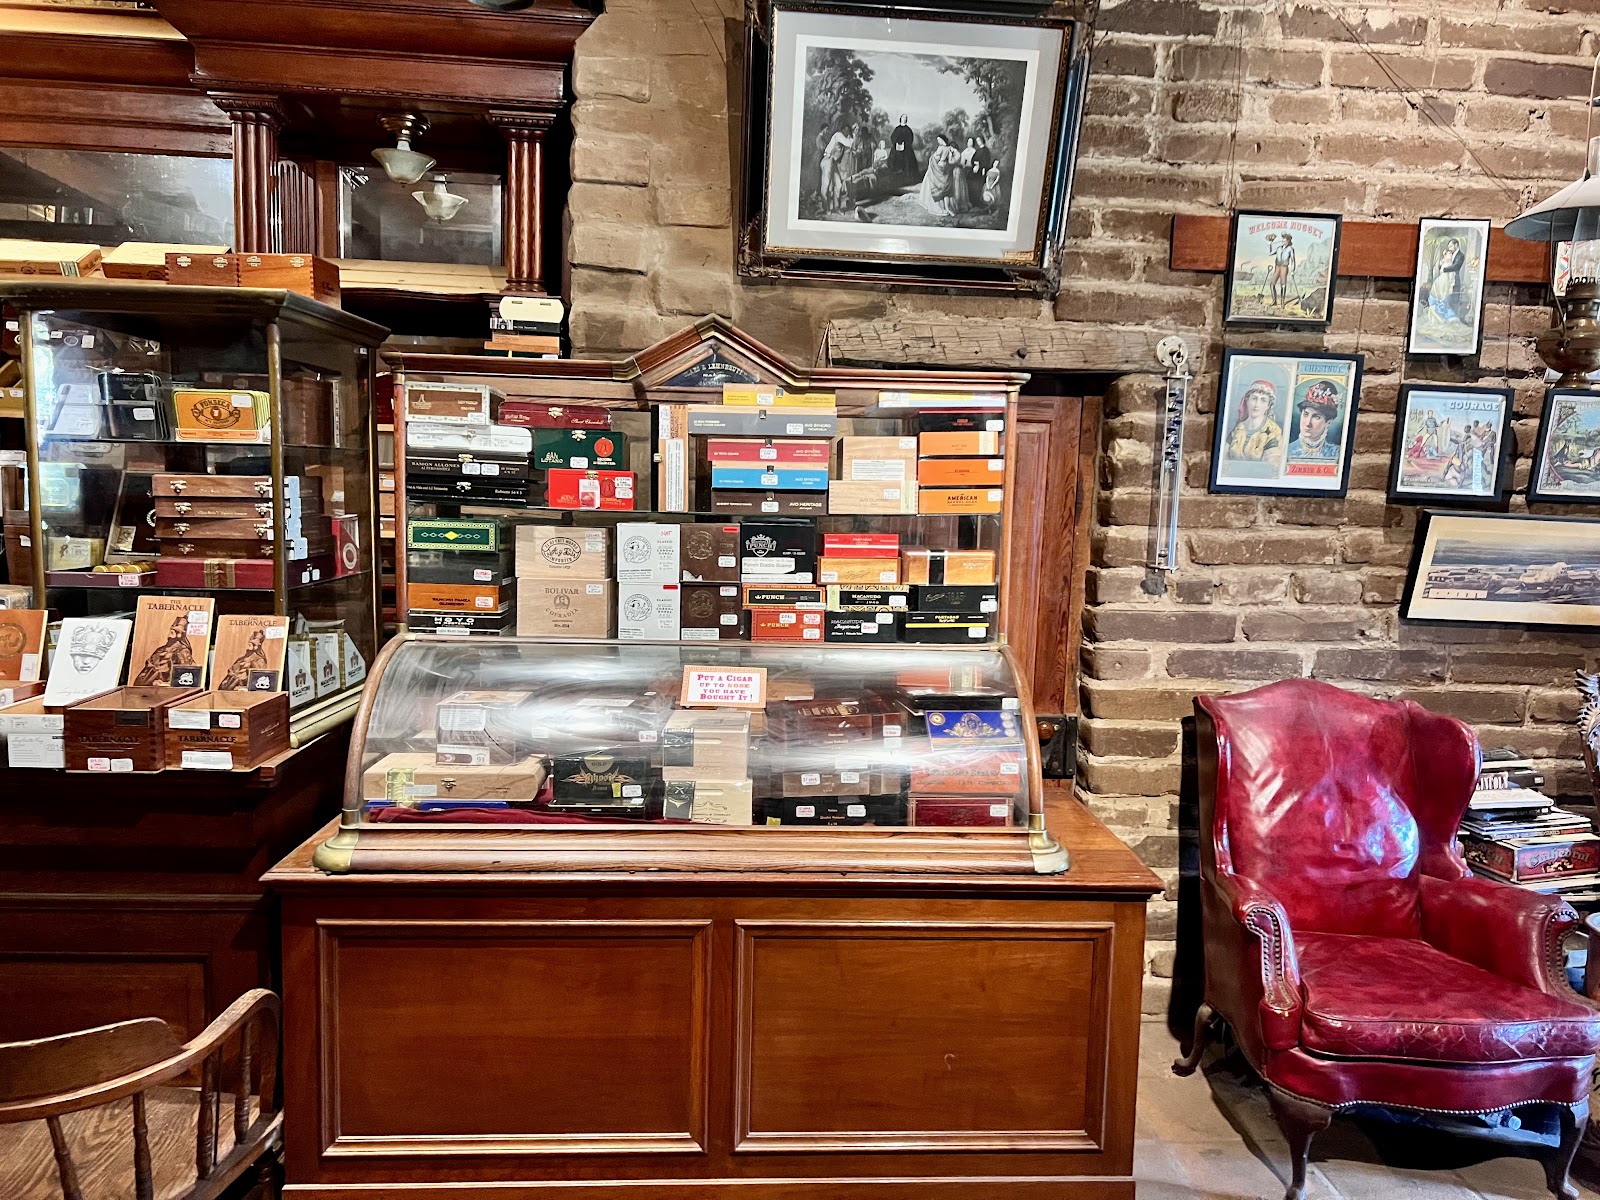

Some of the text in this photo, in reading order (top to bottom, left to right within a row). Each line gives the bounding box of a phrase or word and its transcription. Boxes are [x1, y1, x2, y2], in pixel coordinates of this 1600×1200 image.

[1248, 220, 1323, 239] WELCOME NUGGET
[199, 398, 231, 409] FONSECA
[1449, 401, 1500, 412] COURAGE
[1316, 466, 1321, 474] &
[545, 587, 579, 595] BOLIVAR
[147, 602, 205, 612] TABERNACLE
[545, 607, 579, 618] COFRADIA
[229, 618, 277, 627] TABERNACLE
[434, 616, 475, 624] HOYO
[697, 674, 715, 682] PUT
[726, 674, 753, 682] CIGAR
[699, 693, 735, 701] BOUGHT
[78, 735, 142, 745] TABERNACLE
[178, 735, 238, 744] TABERNACLE
